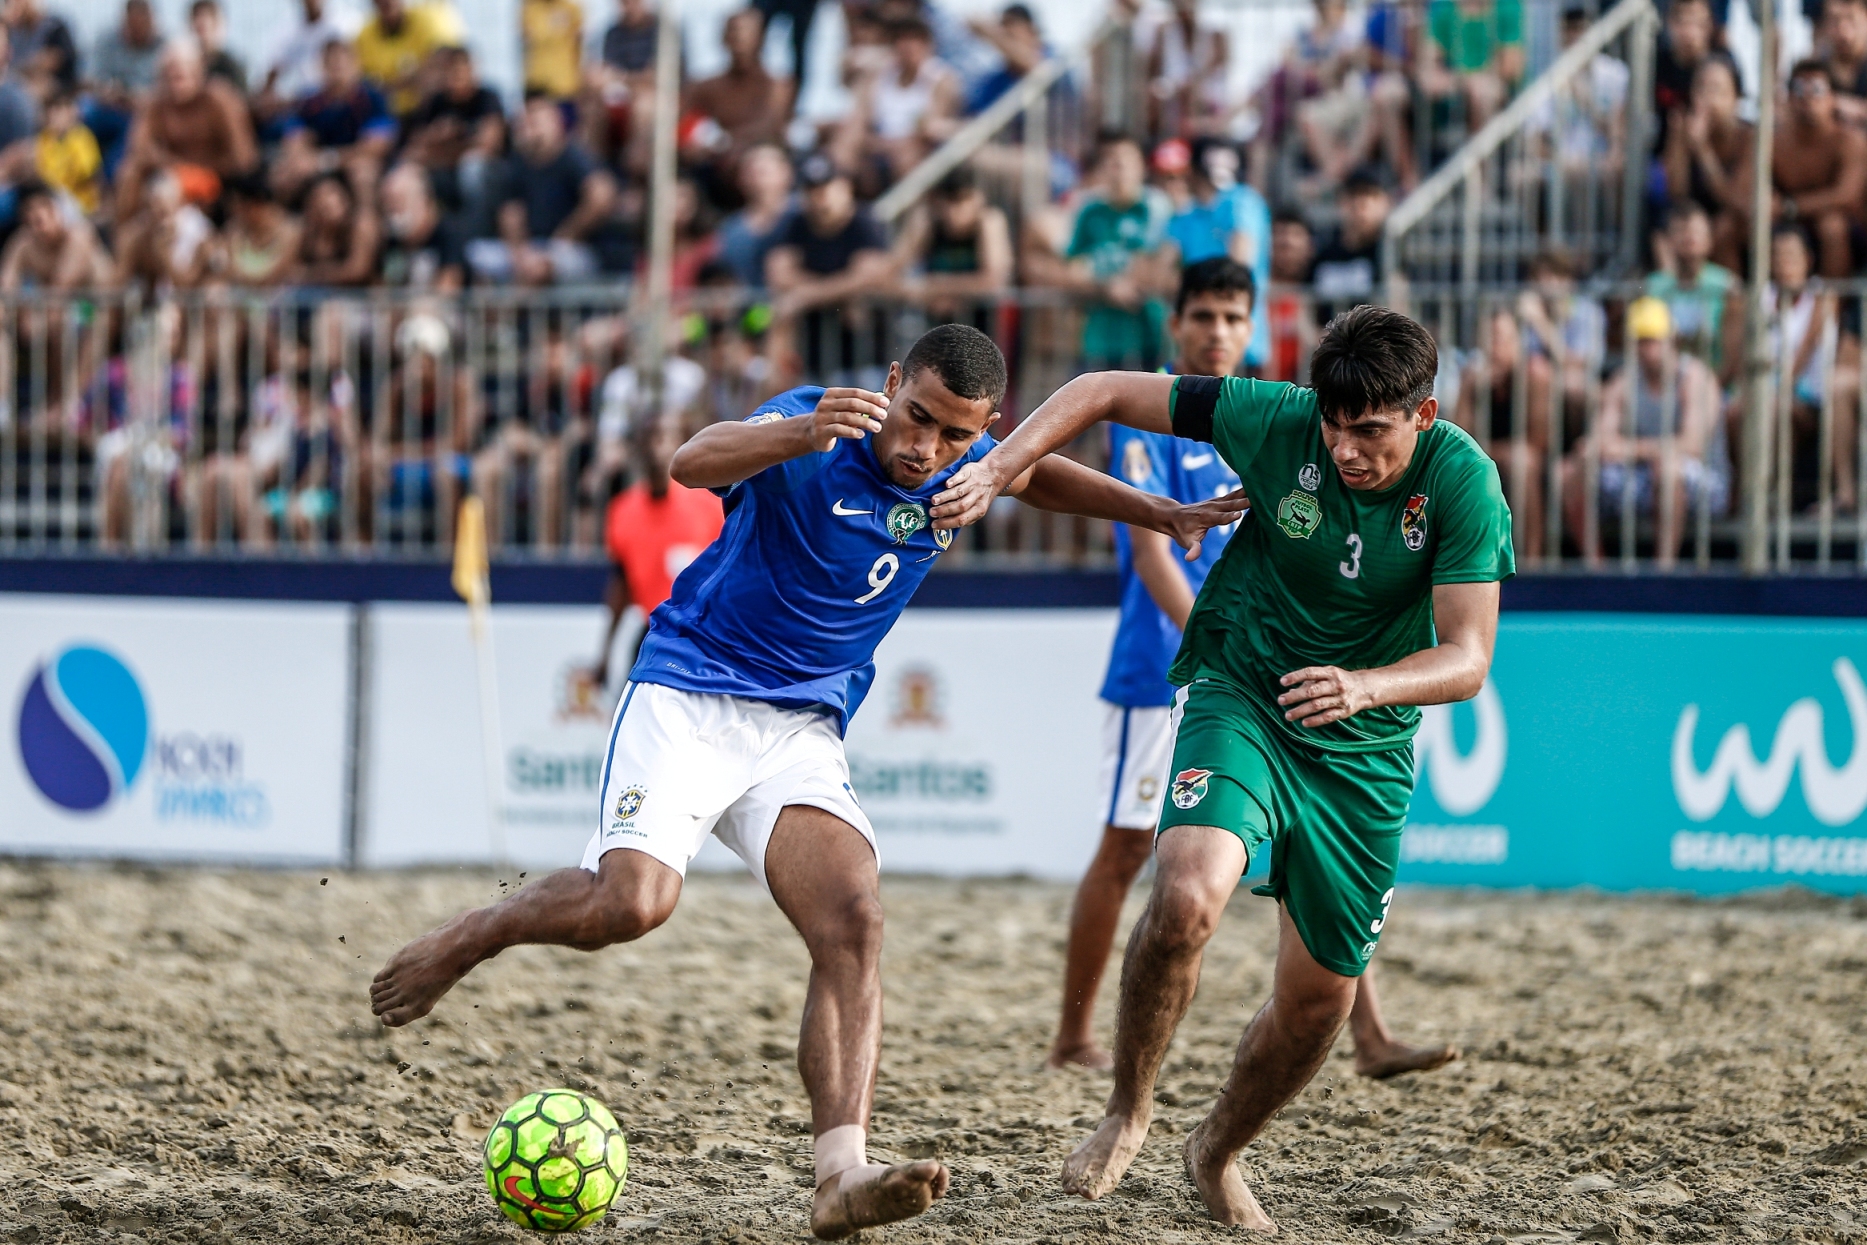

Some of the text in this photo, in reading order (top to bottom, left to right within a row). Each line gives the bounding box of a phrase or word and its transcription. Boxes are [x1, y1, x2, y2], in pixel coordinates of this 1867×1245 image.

[854, 553, 900, 605] 9
[1339, 533, 1363, 579] 3
[507, 747, 604, 794] Sant
[611, 821, 636, 829] BRASIL
[621, 829, 648, 838] SOCCER
[1370, 887, 1395, 934] 3
